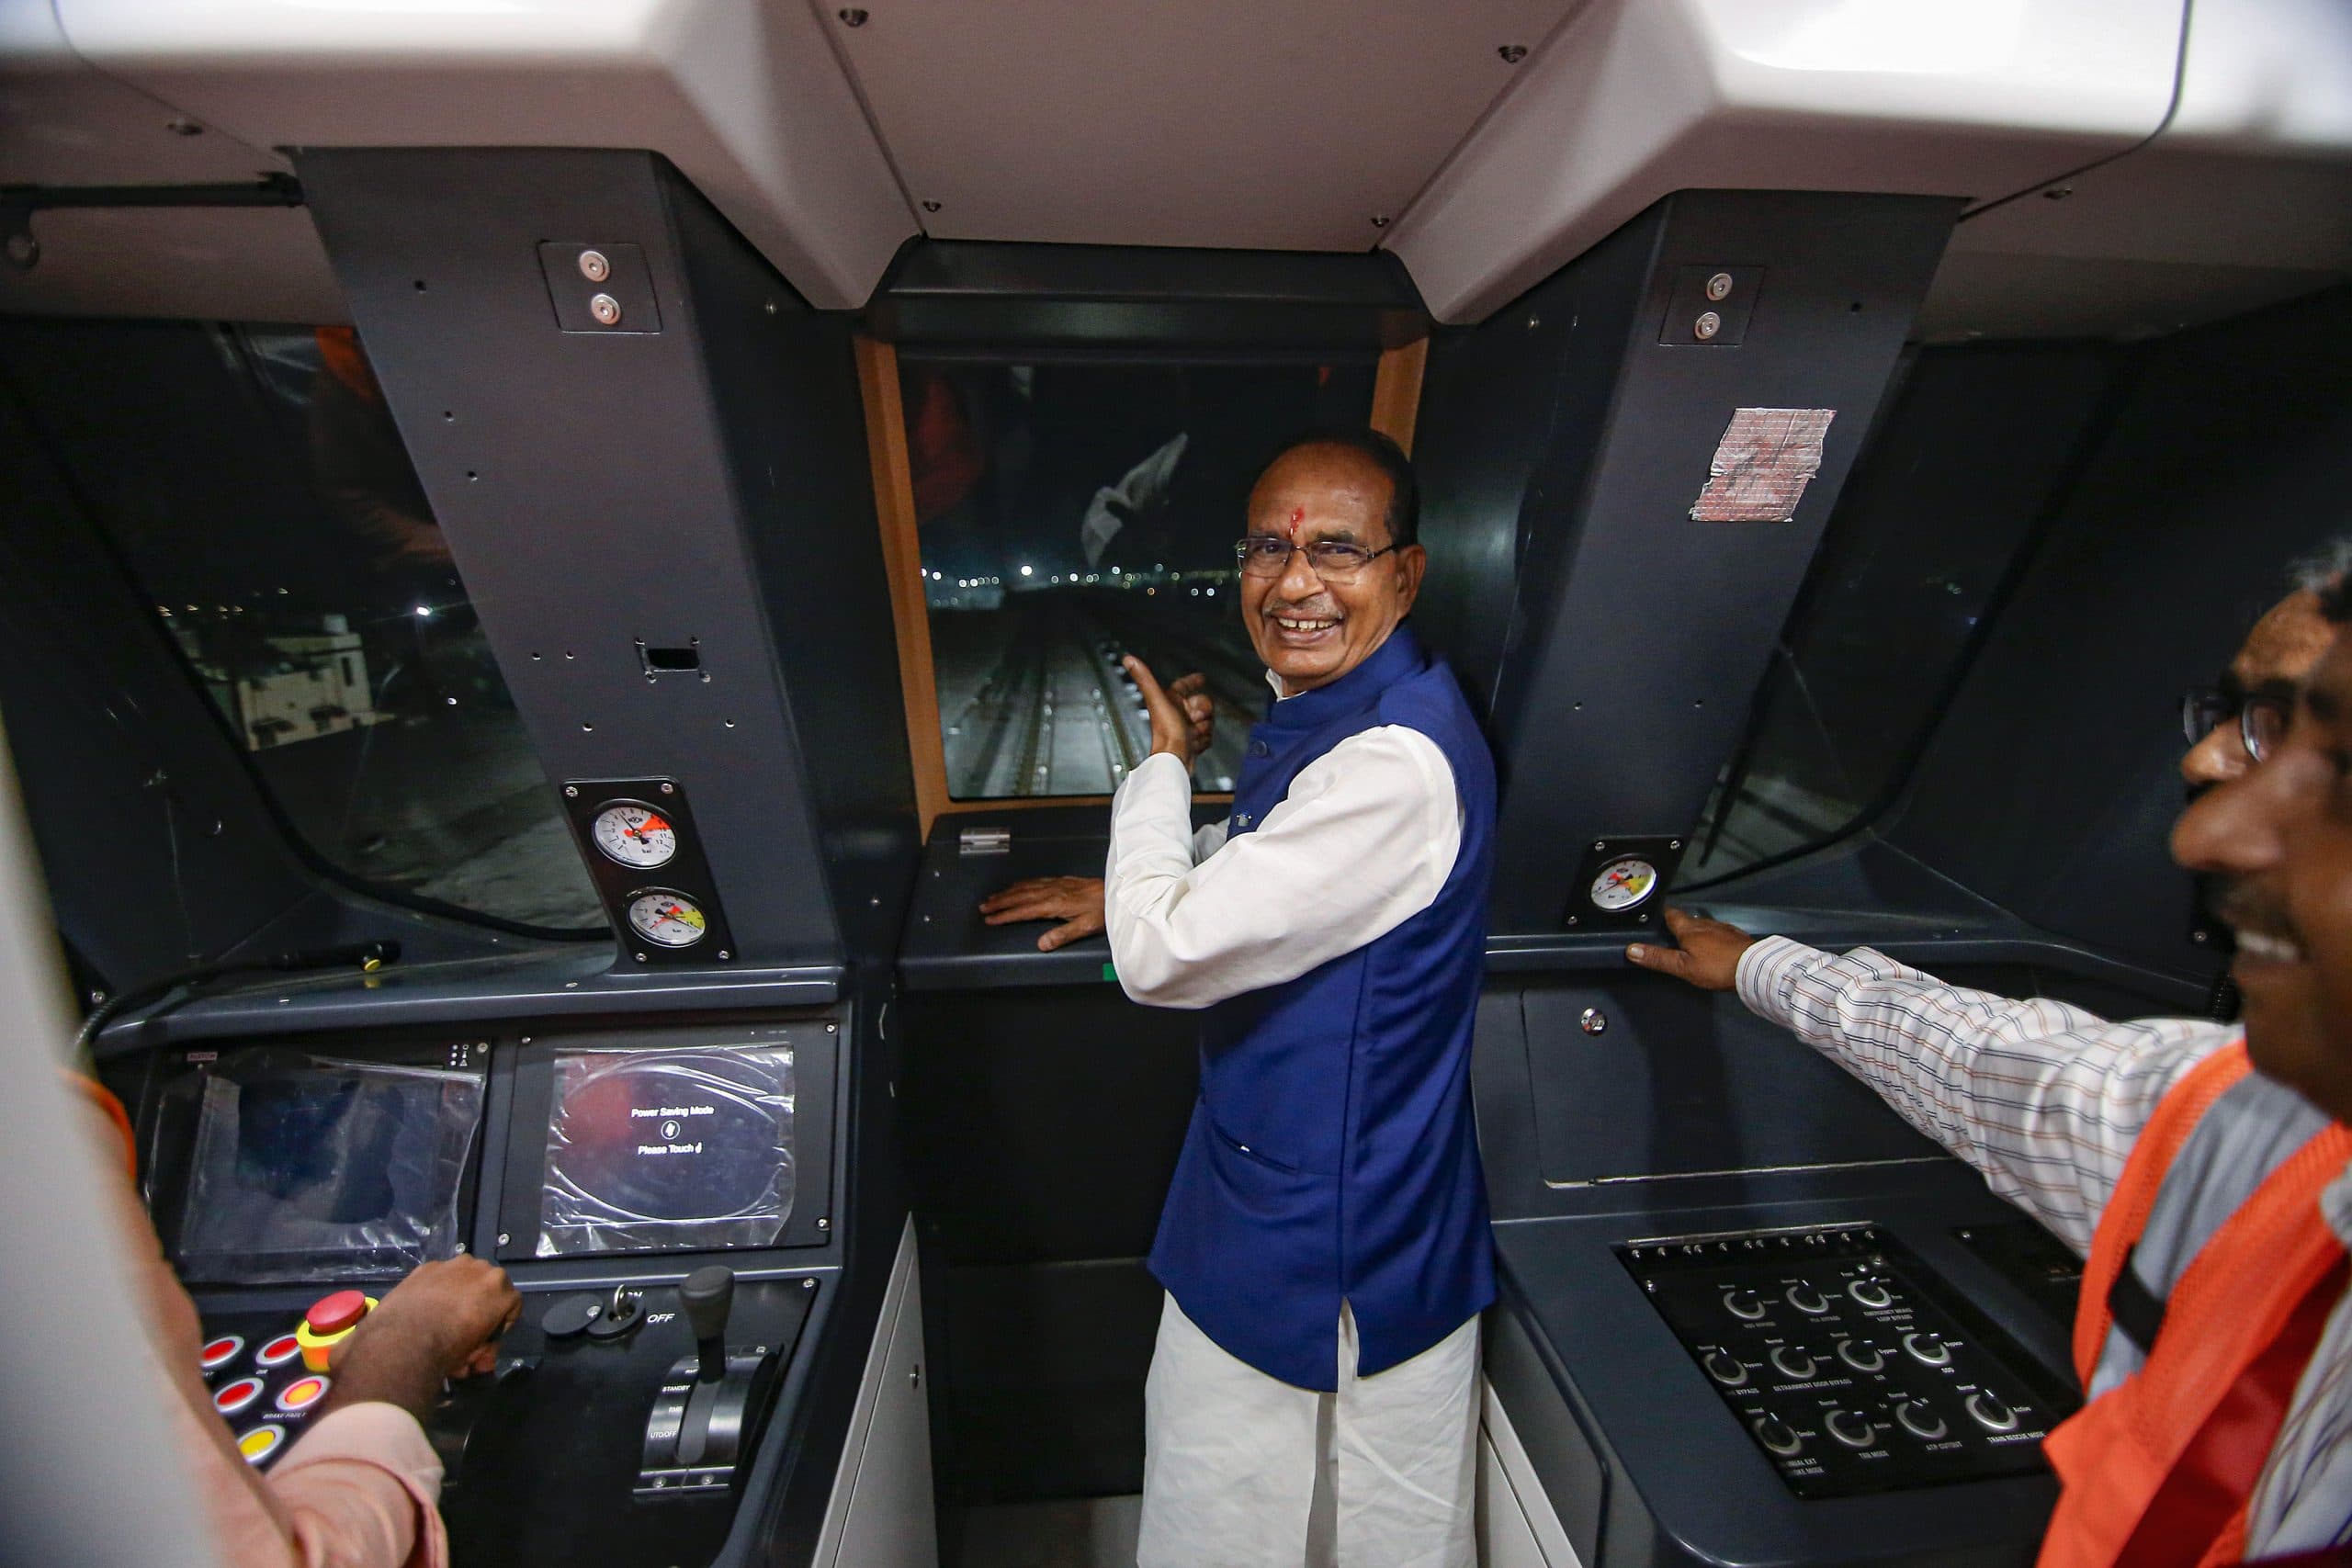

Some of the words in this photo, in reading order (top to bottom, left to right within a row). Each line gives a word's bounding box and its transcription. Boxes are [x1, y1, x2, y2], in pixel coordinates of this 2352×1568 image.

[631, 1108, 659, 1118] Power
[660, 1106, 689, 1117] Saving
[690, 1105, 715, 1115] Mode
[638, 1145, 667, 1155] Please
[668, 1143, 694, 1154] Touch
[647, 1313, 675, 1324] OFF
[662, 1384, 691, 1393] STANDBY
